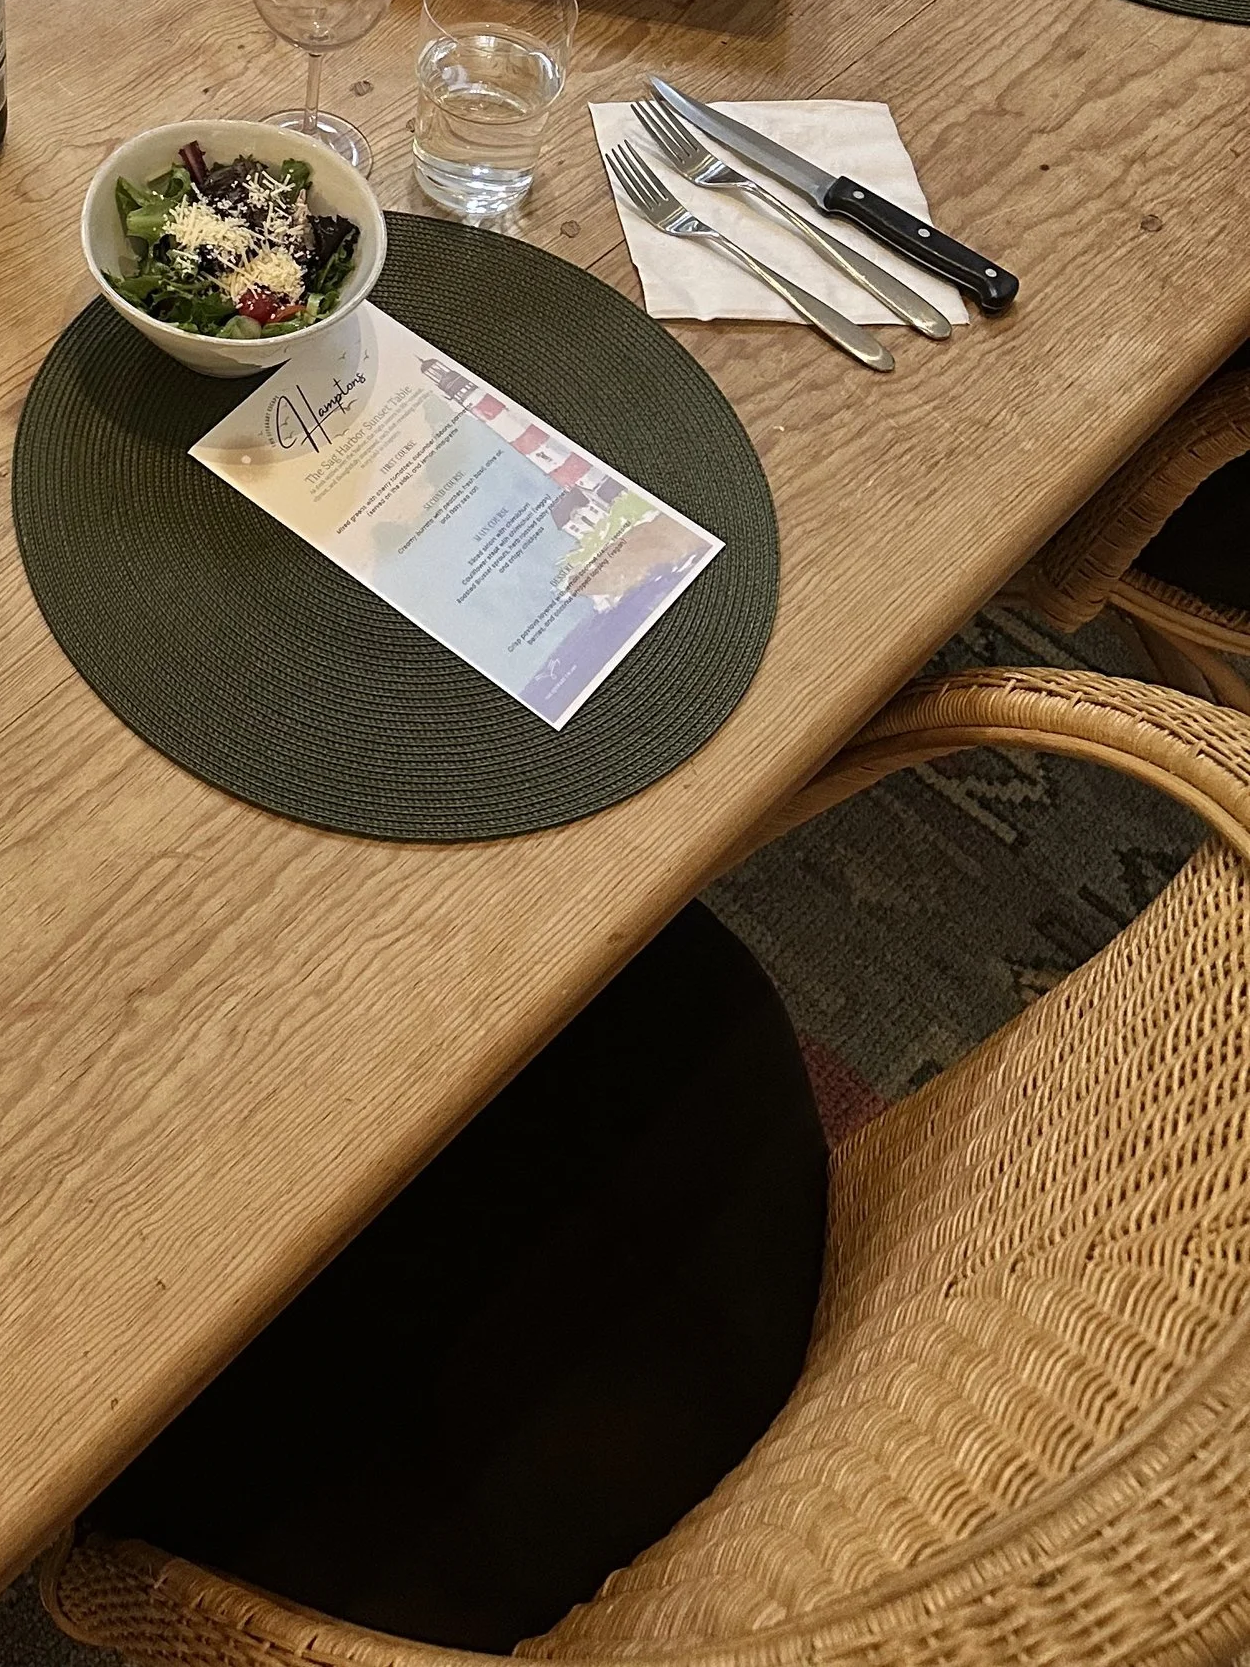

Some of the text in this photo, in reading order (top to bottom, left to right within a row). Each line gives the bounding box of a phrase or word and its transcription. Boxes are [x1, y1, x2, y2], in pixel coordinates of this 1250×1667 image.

[276, 373, 364, 453] Hamptons
[303, 466, 327, 487] The
[319, 452, 342, 472] Sag
[334, 427, 369, 457] Harbor
[361, 403, 394, 432] Sunset
[387, 384, 415, 408] Table
